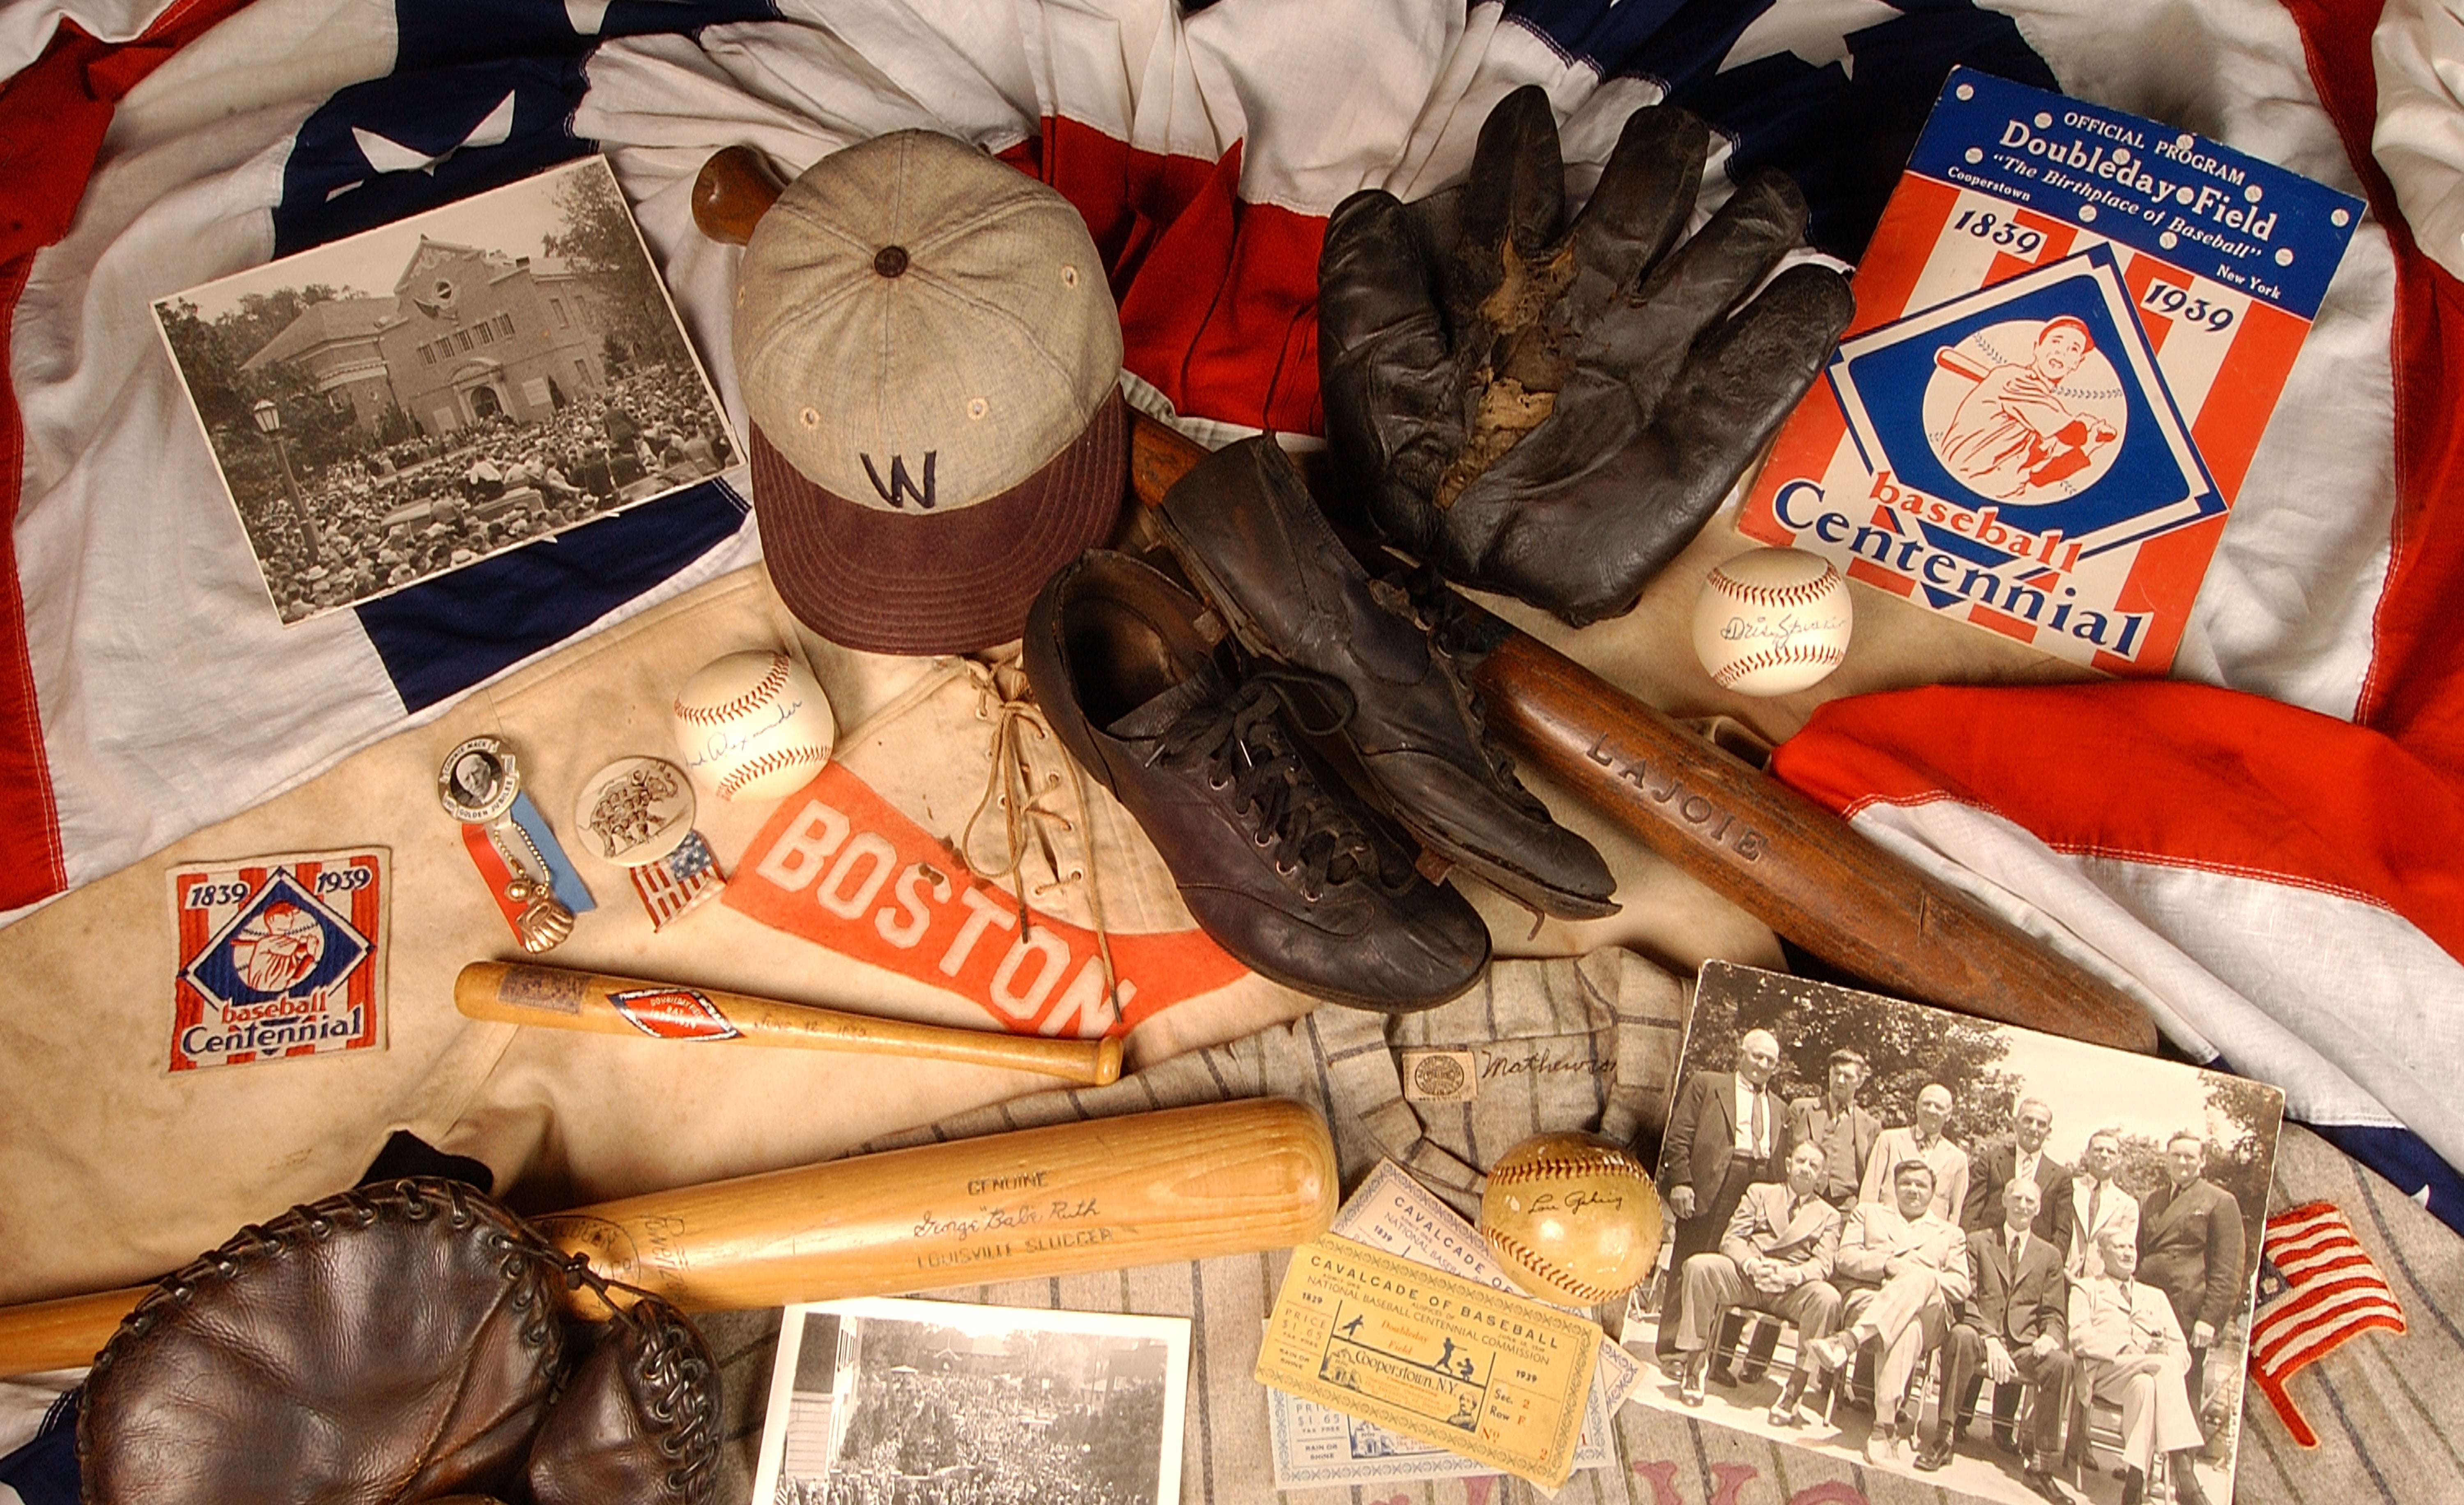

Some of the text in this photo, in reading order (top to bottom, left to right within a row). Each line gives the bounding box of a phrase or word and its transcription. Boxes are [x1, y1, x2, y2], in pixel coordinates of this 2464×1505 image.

[2064, 112, 2245, 186] OFFICIAL PROGRAM
[1947, 166, 2031, 201] Cooperstown
[2000, 119, 2277, 242] Doubleday Field
[2045, 169, 2140, 216] Birthplace
[2144, 205, 2165, 226] of
[1953, 211, 2042, 254] 1839
[2217, 265, 2281, 300] New York
[2145, 284, 2234, 332] 1939
[860, 450, 936, 508] W
[1869, 471, 2082, 573] baseball
[1774, 481, 2143, 656] Centennial
[460, 809, 488, 818] GOLDEN
[1586, 731, 1768, 861] LAJOIE
[190, 883, 248, 907] 1839
[317, 869, 370, 893] 1939
[755, 799, 1137, 1037] BOSTON
[222, 990, 326, 1023] baseball
[183, 1007, 361, 1054] Centennial
[968, 1171, 1048, 1195] GENUINE
[1050, 1198, 1101, 1220] Ruth
[917, 1227, 1112, 1268] LOUISVILLE SLUGGER
[1374, 1225, 1392, 1242] 1839
[1385, 1212, 1465, 1277] NATIONAL BASEBA
[1395, 1196, 1485, 1273] CAVALCADE
[1285, 1308, 1326, 1327] PRICE
[1308, 1275, 1549, 1365] NATIONAL BASEBALL CENTENNIAL COMMISSION
[1311, 1255, 1558, 1349] CAVALCADE OF BASEBALL
[1381, 1319, 1429, 1343] Doubleday
[1388, 1340, 1413, 1355] Field
[1437, 1376, 1457, 1396] N.Y.
[1516, 1369, 1537, 1383] 1939
[1490, 1405, 1510, 1421] Row
[1495, 1388, 1513, 1404] Sec.
